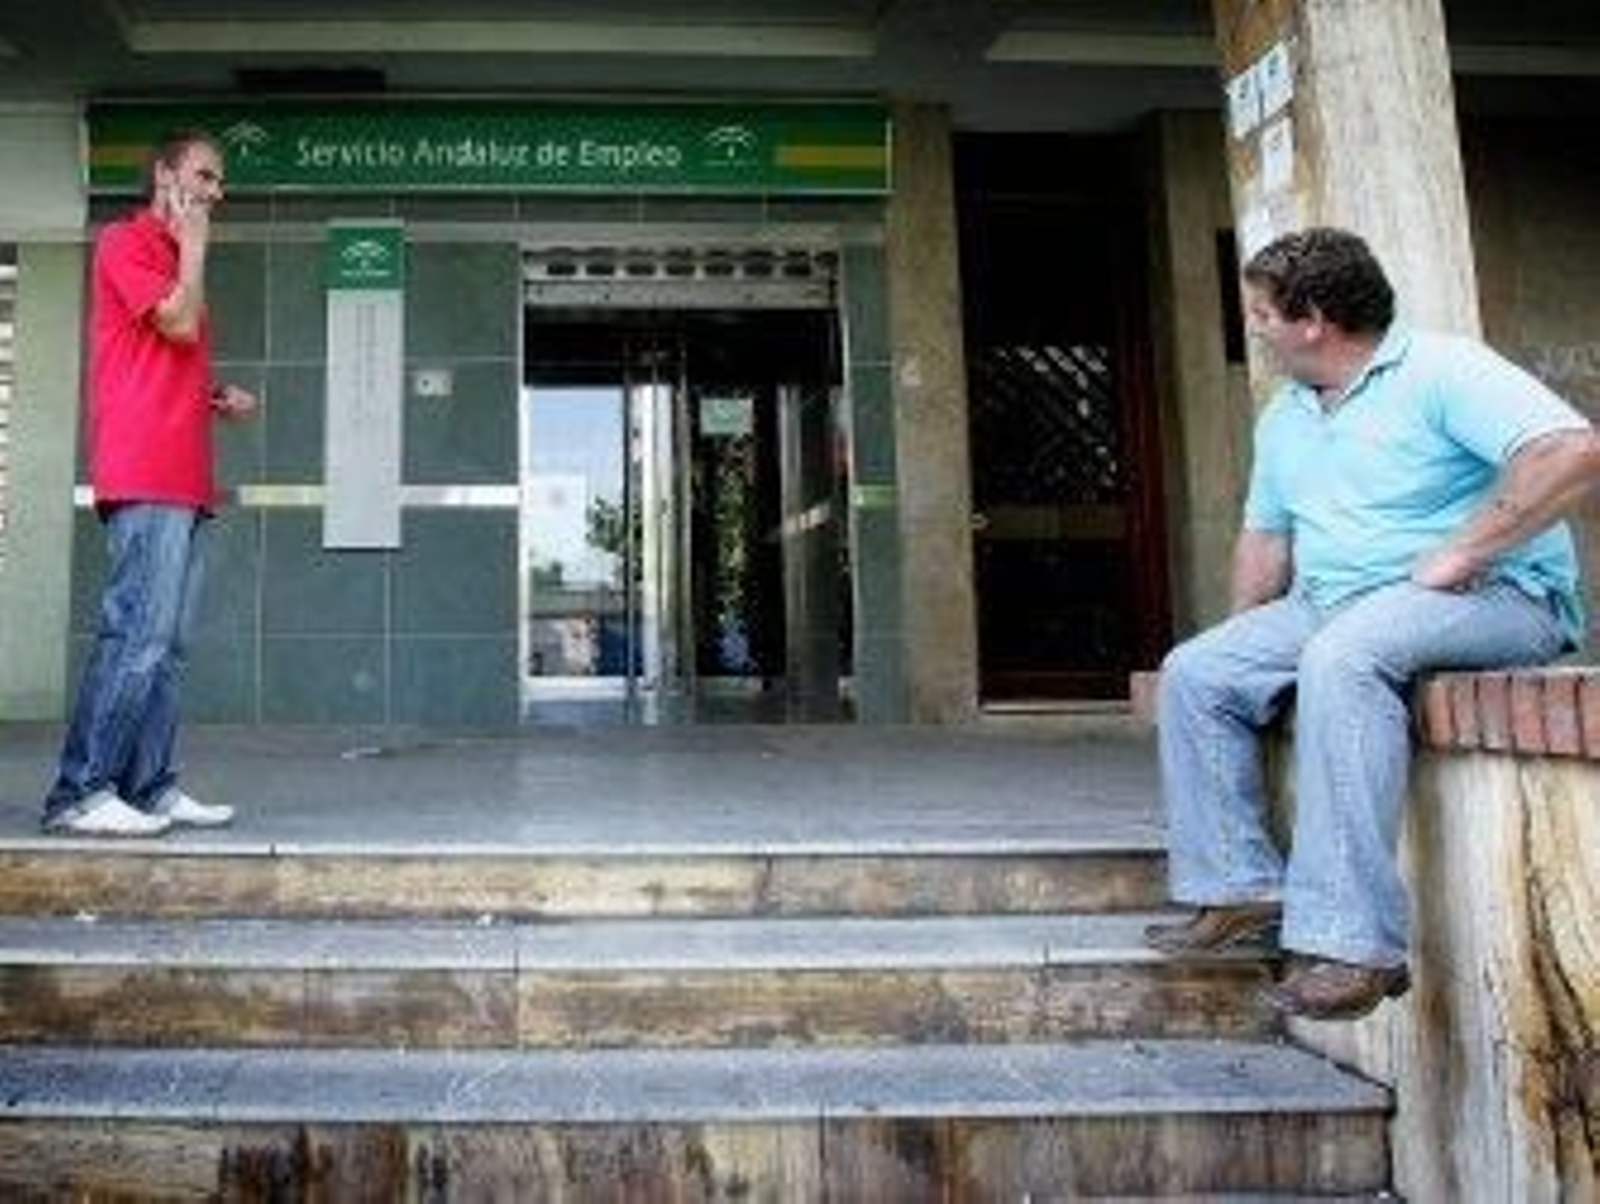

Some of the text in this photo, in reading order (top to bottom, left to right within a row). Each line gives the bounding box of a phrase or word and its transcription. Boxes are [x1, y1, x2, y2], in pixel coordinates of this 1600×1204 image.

[295, 137, 682, 173] Servicio Andaluz de Empleo
